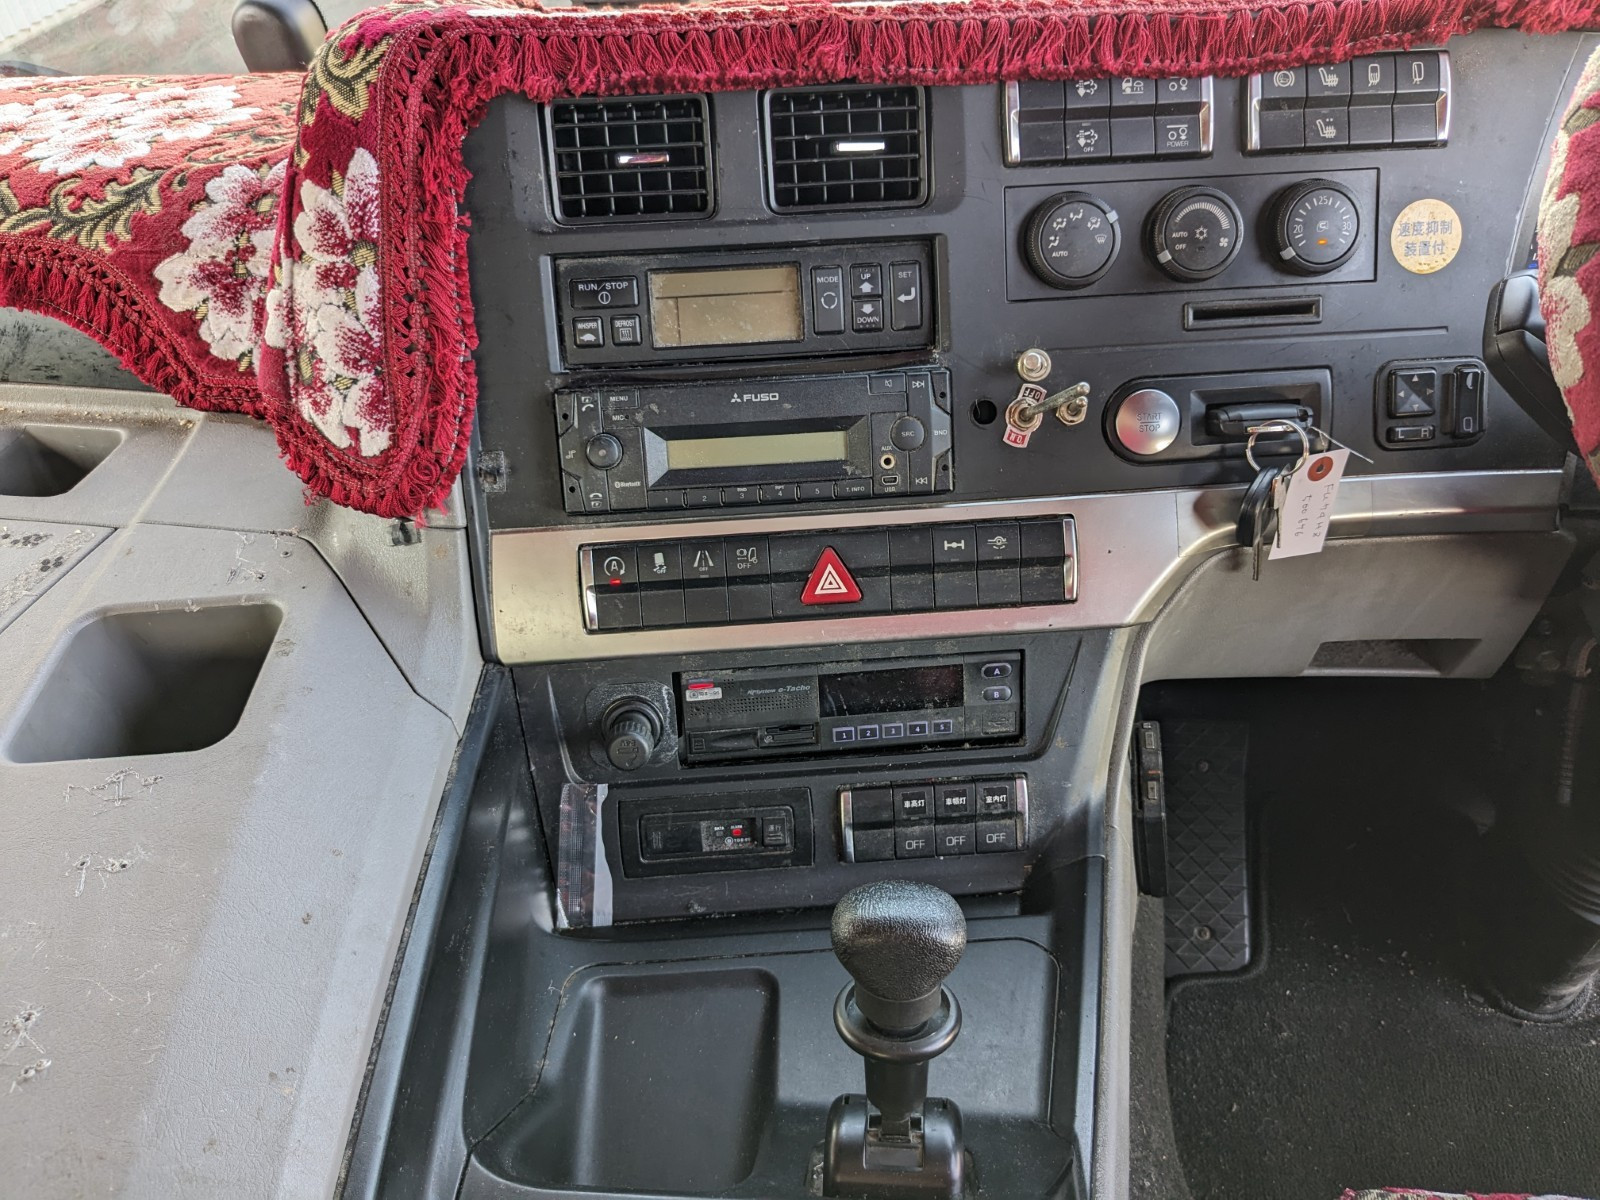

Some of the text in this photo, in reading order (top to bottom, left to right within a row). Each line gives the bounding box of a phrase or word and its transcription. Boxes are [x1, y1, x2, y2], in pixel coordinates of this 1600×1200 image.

[1166, 140, 1189, 148] POWER
[1318, 196, 1328, 205] 25
[1293, 224, 1304, 234] 20
[1342, 222, 1352, 230] 30
[1398, 220, 1453, 238] 速度抑制
[1404, 240, 1446, 258] 装置付
[1052, 250, 1068, 258] AUTO
[816, 275, 840, 284] MODE
[860, 272, 871, 280] UP
[898, 271, 912, 279] SET
[578, 281, 629, 292] RUN/STOP
[614, 320, 635, 328] DEFROST
[856, 316, 880, 324] DOWN
[576, 321, 598, 330] WHISPER
[743, 392, 780, 402] FUSO
[1024, 388, 1041, 399] OFF
[1136, 412, 1162, 421] START
[1138, 424, 1161, 432] STOP
[1398, 428, 1404, 438] L
[1421, 428, 1430, 438] R
[1010, 432, 1022, 444] ON
[737, 562, 751, 570] OFF
[777, 684, 811, 693] e-Tacho
[904, 799, 925, 808] 車高灯
[985, 794, 1007, 804] 室内灯
[946, 836, 966, 846] OFF
[986, 833, 1006, 844] OFF
[905, 840, 926, 850] OFF
